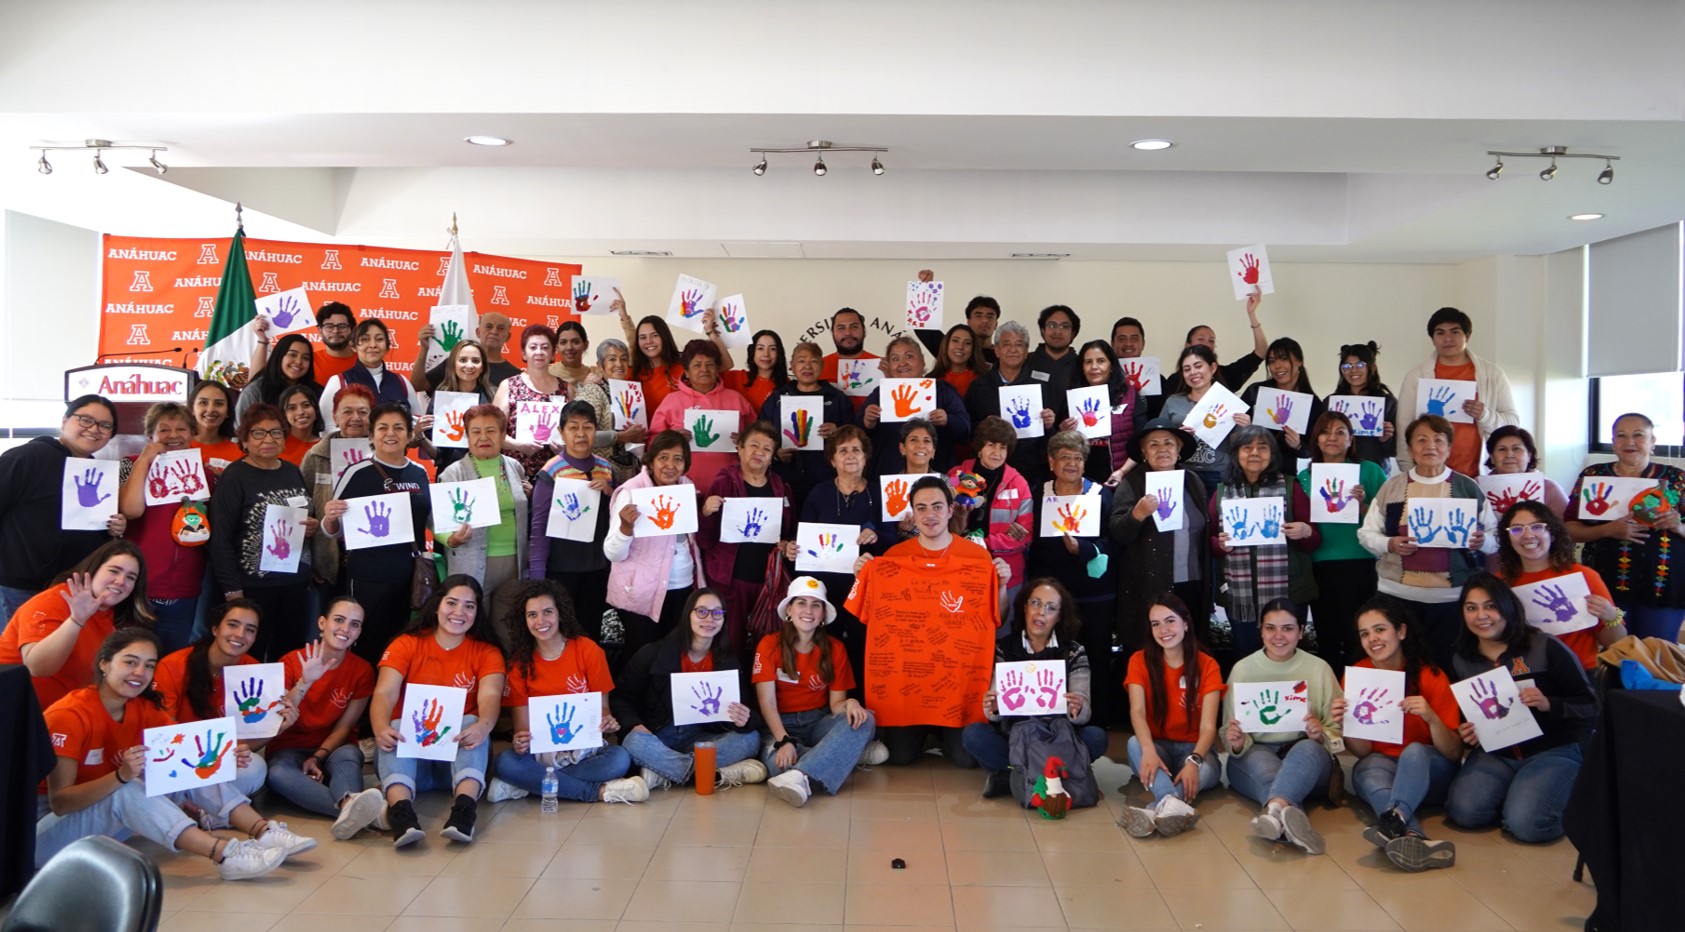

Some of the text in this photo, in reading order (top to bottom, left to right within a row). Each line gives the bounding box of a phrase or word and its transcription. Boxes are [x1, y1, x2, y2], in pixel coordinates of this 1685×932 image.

[108, 247, 177, 261] ANÁHUAC
[360, 257, 420, 271] ANÁHUAC
[473, 264, 527, 280] ANÁHUAC
[174, 275, 223, 288] ANÁHU
[301, 280, 362, 292] ANÁHUAC
[105, 301, 174, 315] ANÁHUAC
[527, 295, 572, 308] ANÁHUA
[359, 308, 419, 321] ANÁHUAC
[172, 329, 209, 341] ANÁH
[98, 373, 182, 395] Anáhuac
[520, 403, 560, 414] ALEX
